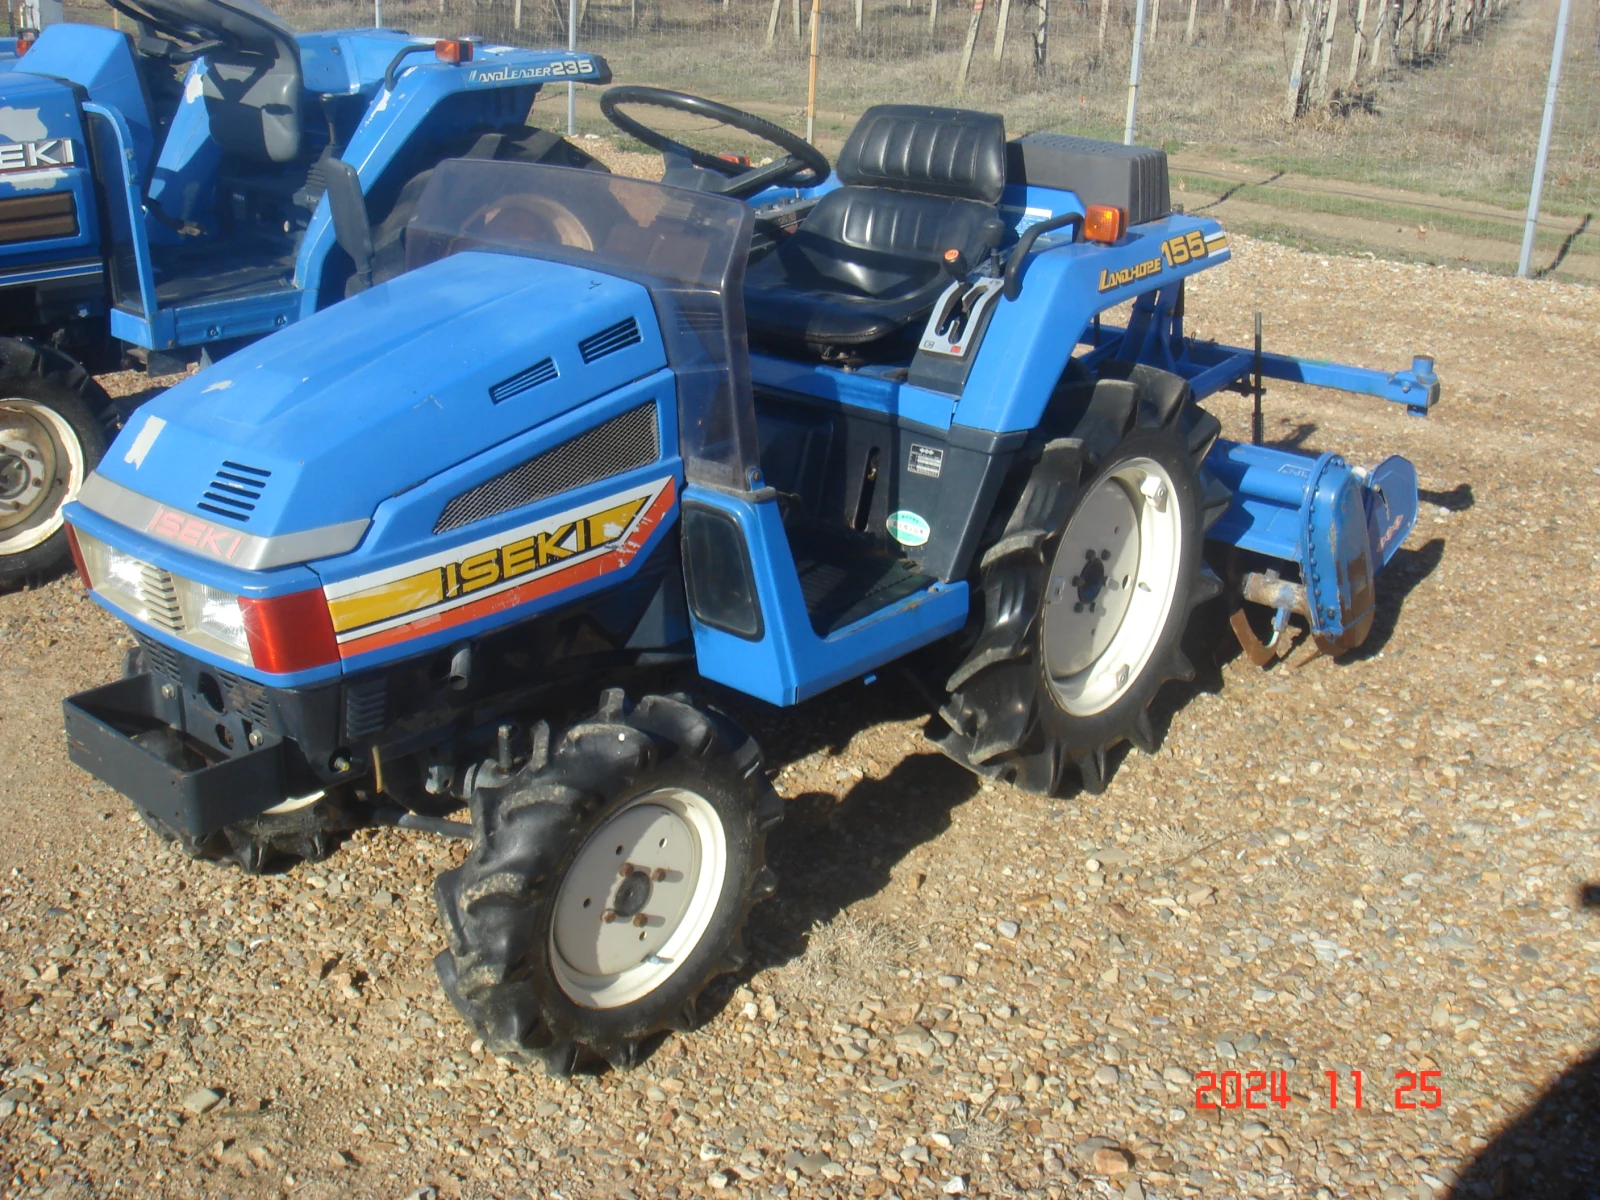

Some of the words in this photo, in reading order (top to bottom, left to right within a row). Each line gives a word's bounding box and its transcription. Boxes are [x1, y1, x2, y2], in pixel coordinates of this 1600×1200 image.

[549, 60, 594, 76] 235
[1160, 229, 1207, 268] 155
[148, 507, 243, 560] ISEKI
[445, 518, 588, 599] ISEKI
